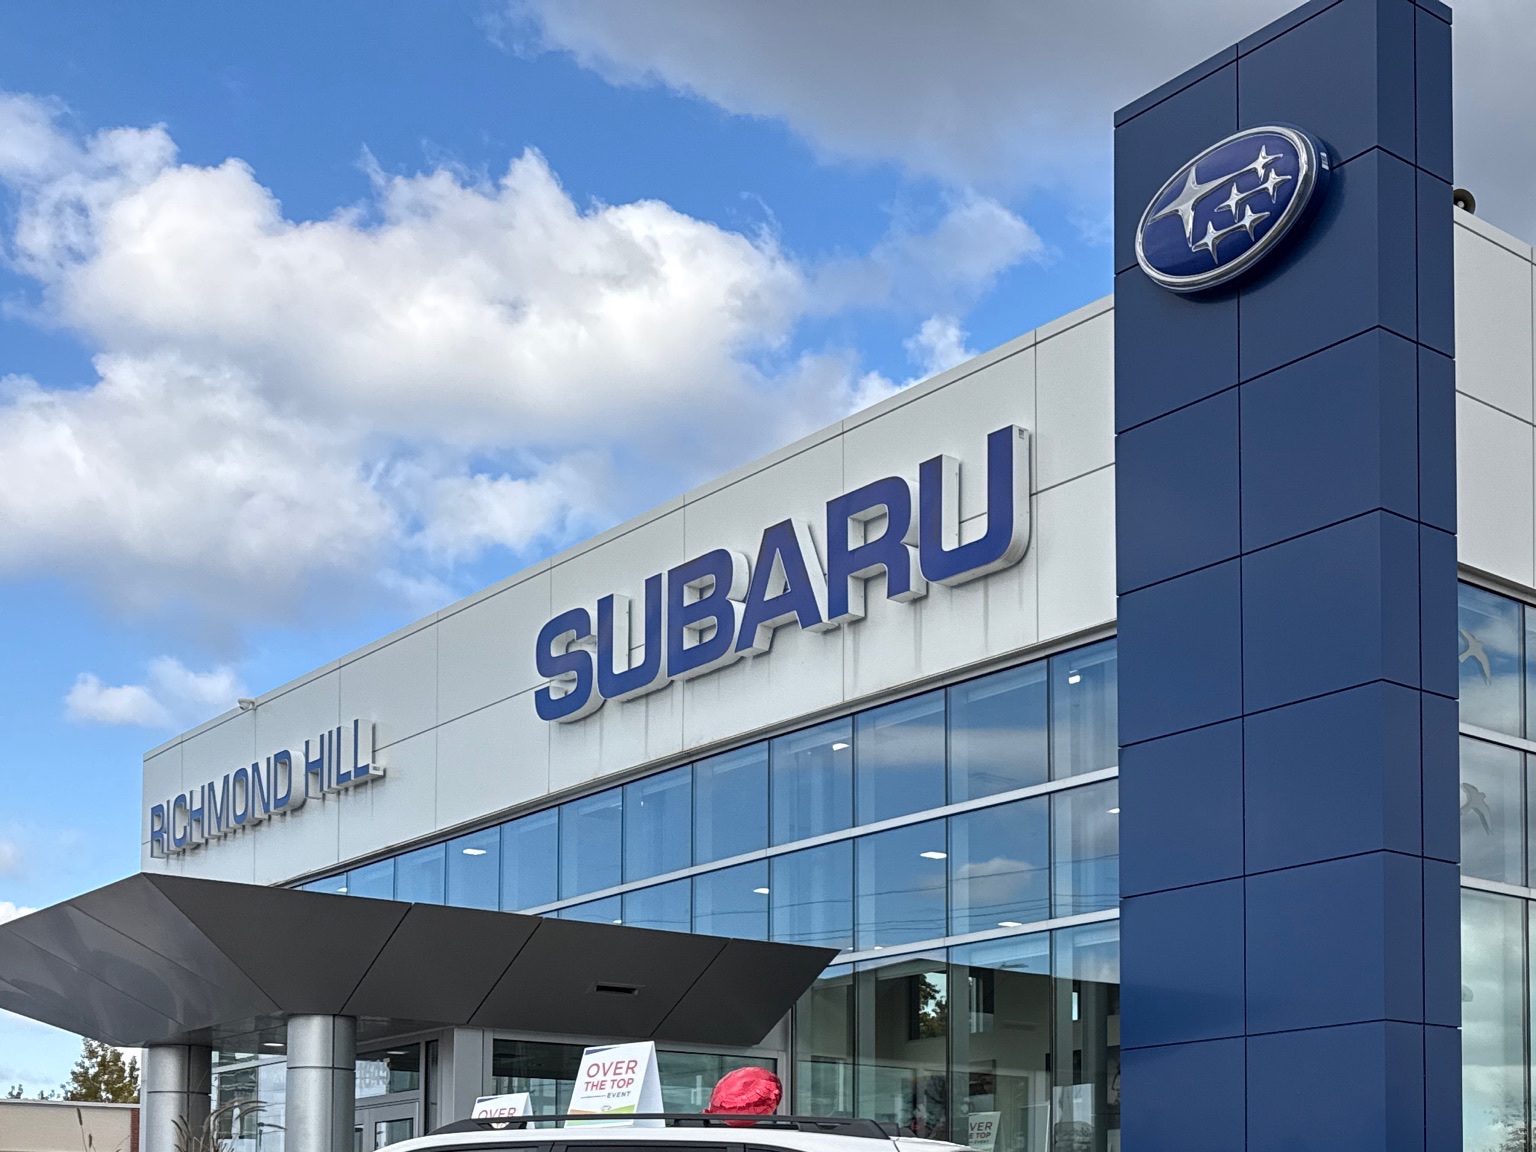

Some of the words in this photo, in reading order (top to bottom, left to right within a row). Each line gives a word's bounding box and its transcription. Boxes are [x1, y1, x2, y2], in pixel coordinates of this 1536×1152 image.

[534, 424, 1028, 723] SUBARU
[150, 749, 299, 857] RICHMOND
[304, 719, 381, 798] HILL
[586, 1059, 638, 1078] OVER
[584, 1080, 608, 1091] THE
[610, 1078, 635, 1089] TOP
[478, 1107, 517, 1118] OVER
[969, 1121, 993, 1132] VER
[976, 1131, 991, 1139] TOP
